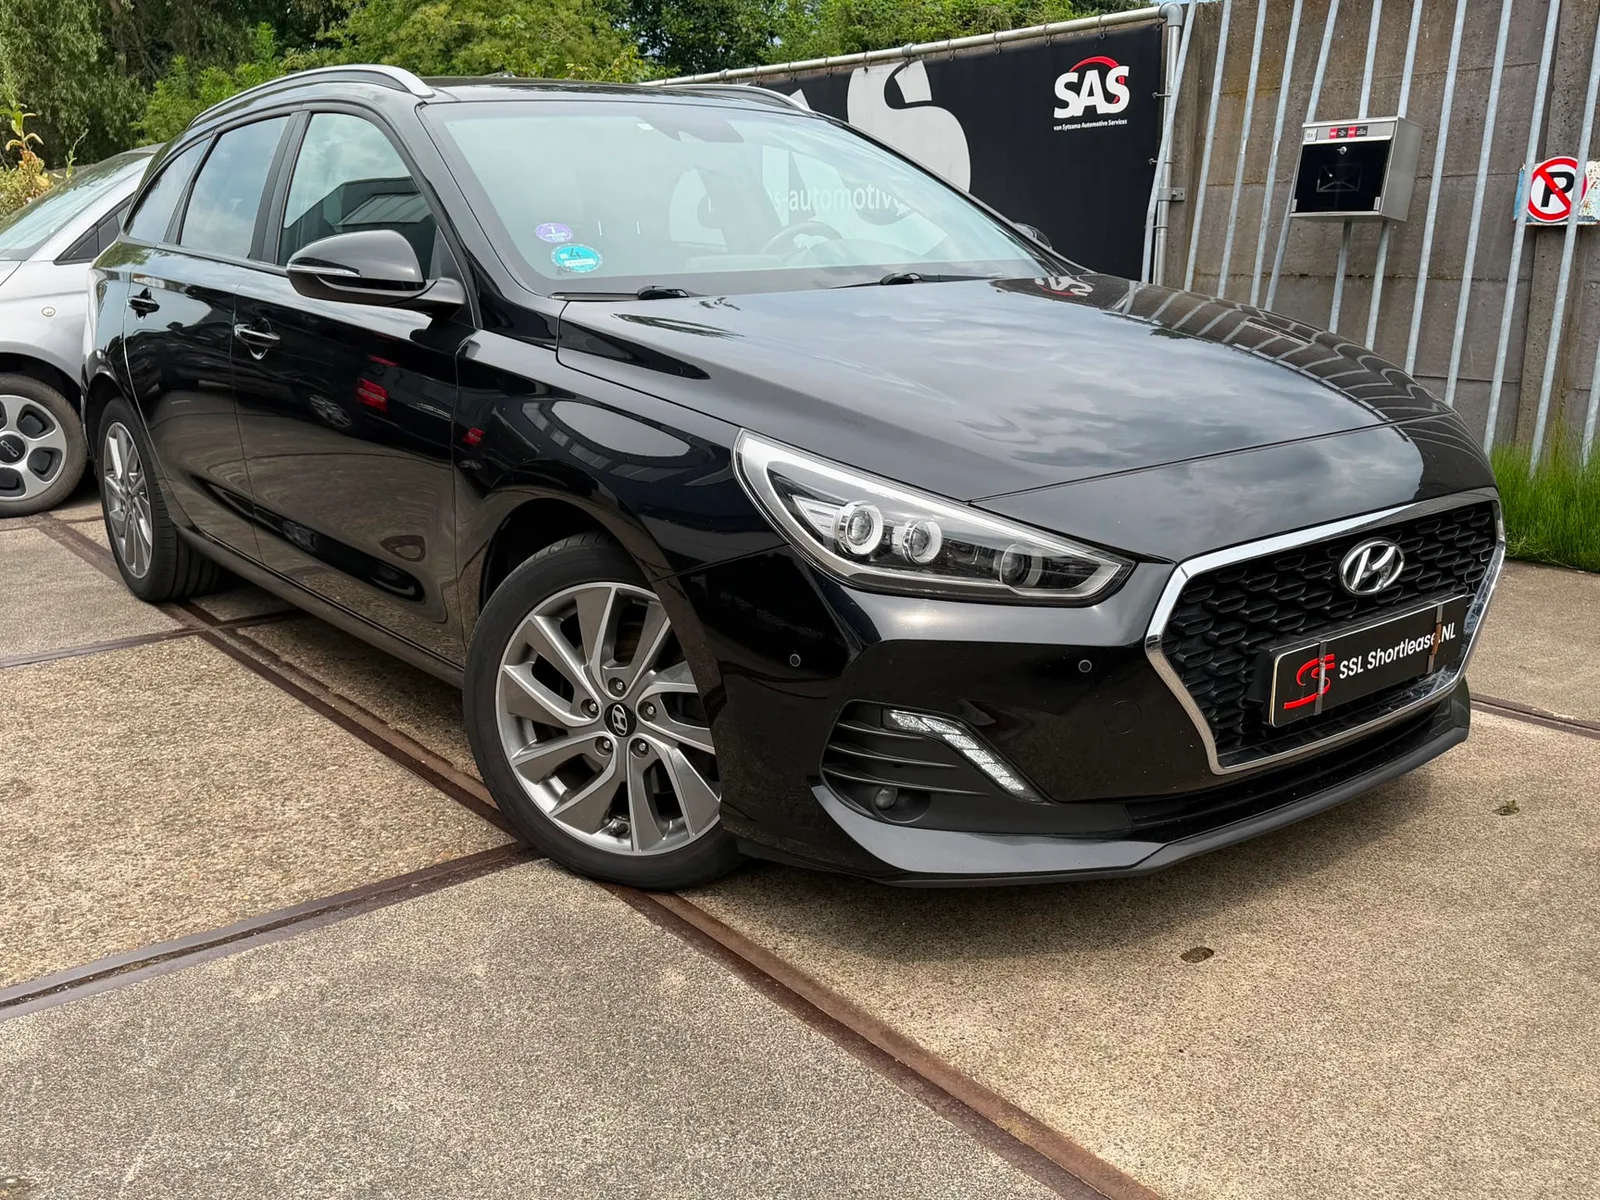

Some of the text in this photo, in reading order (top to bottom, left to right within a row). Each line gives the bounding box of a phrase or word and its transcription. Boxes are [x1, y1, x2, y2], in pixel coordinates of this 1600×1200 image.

[1053, 65, 1131, 119] SAS
[1081, 120, 1108, 128] Automotive
[1108, 118, 1128, 126] Services
[1339, 655, 1364, 679] SSL
